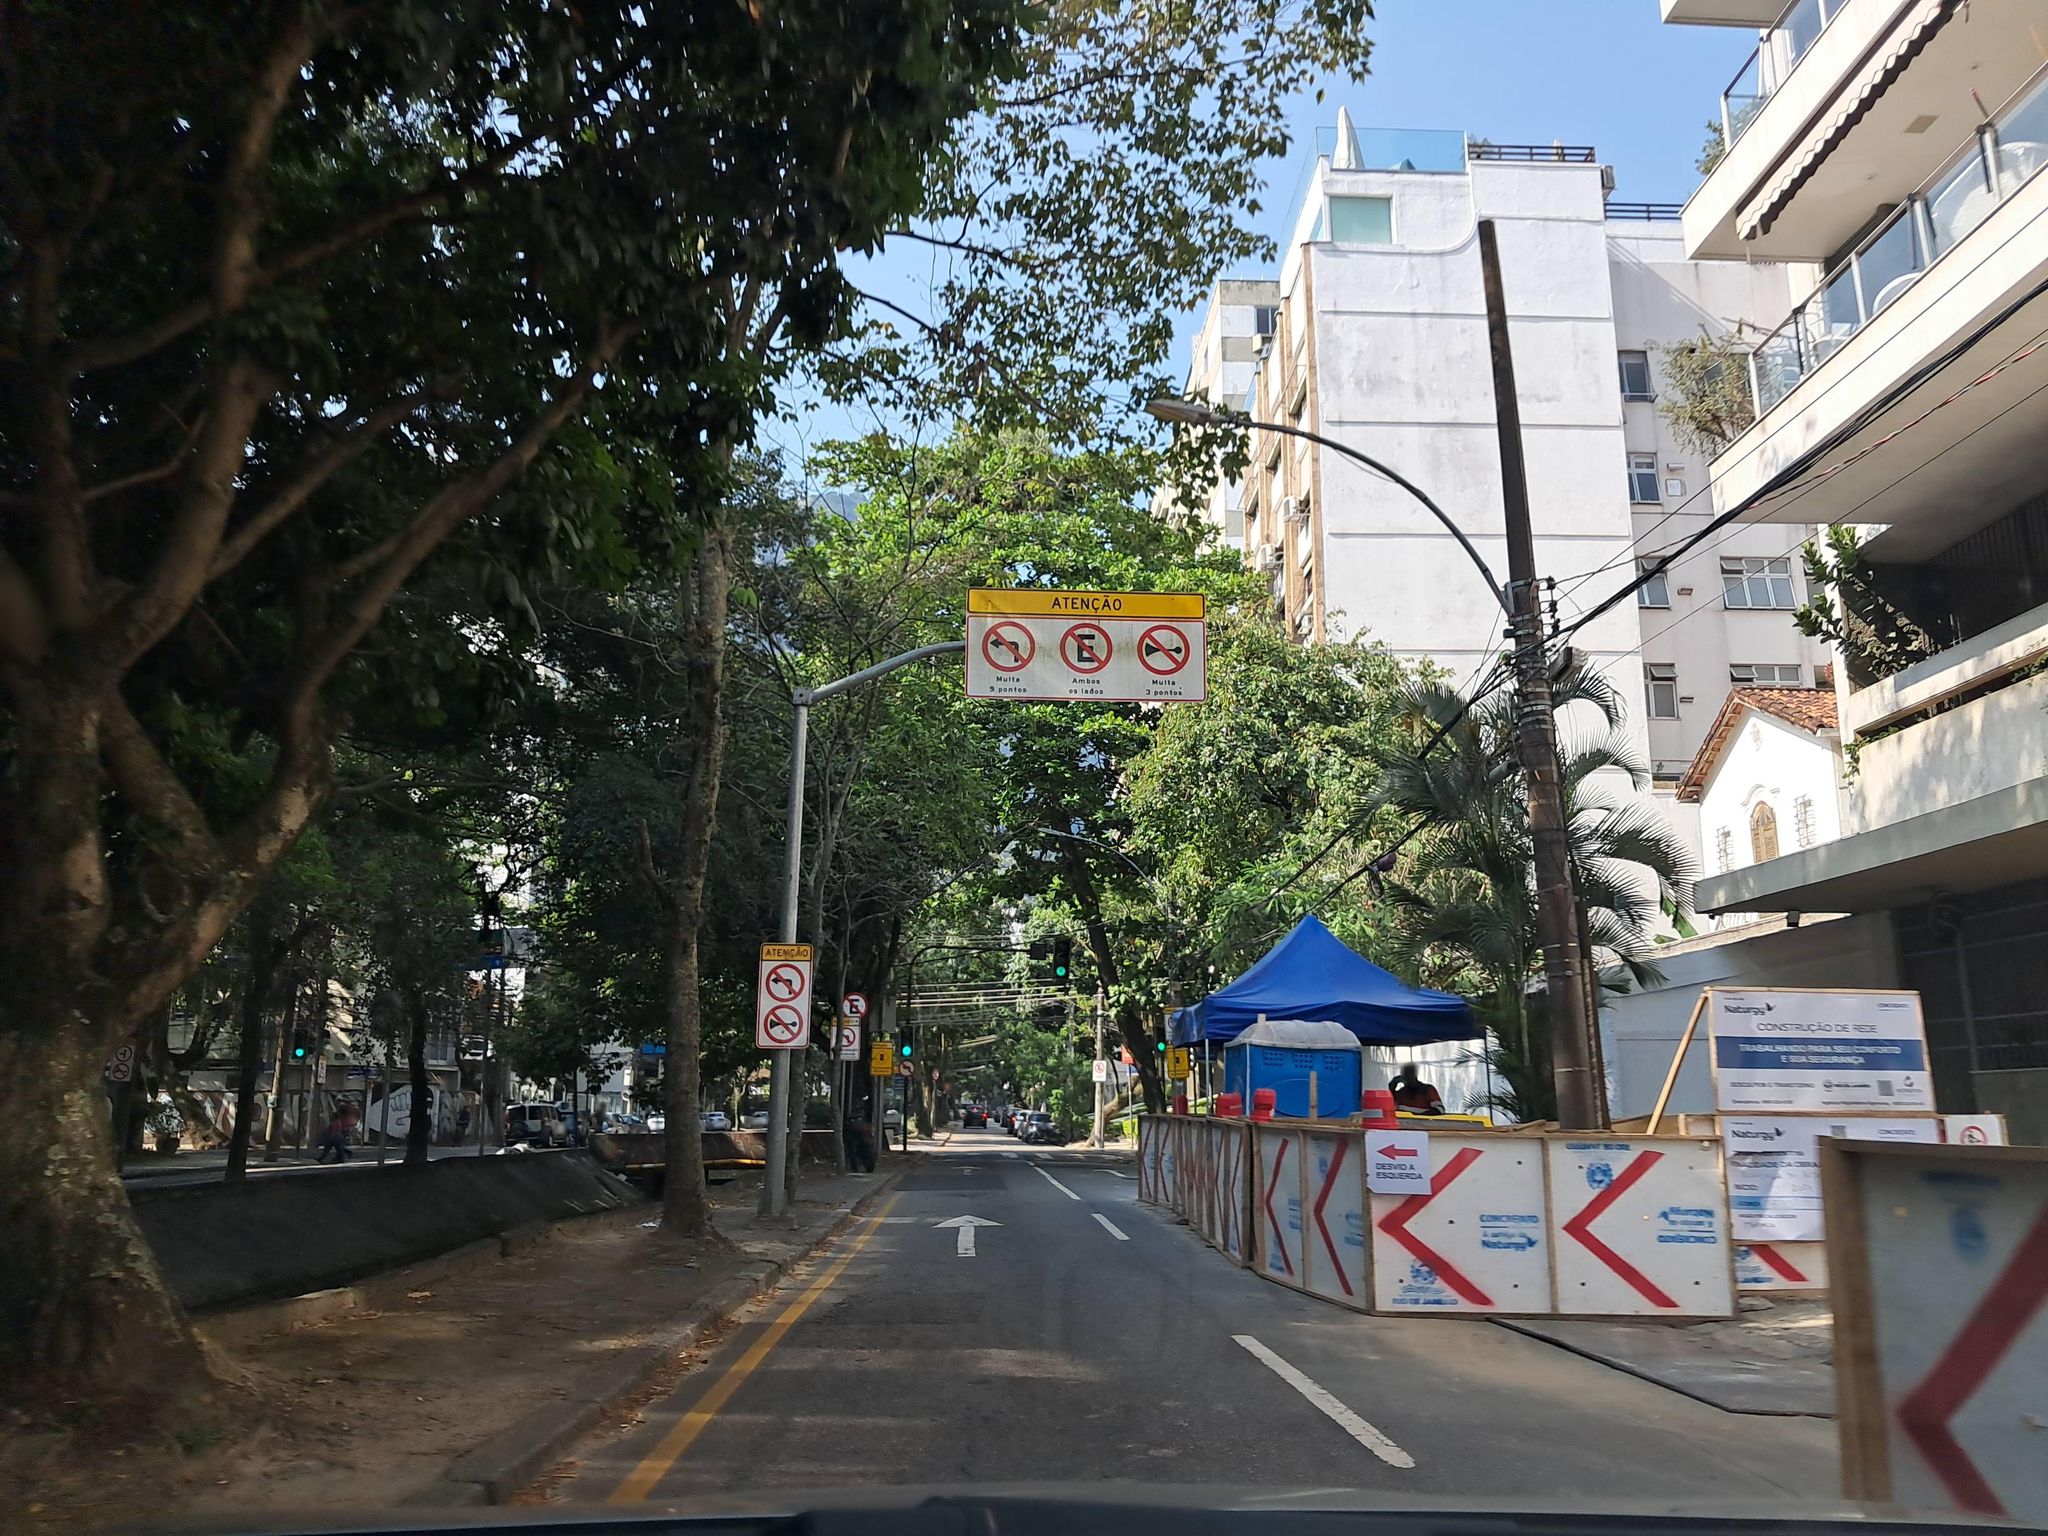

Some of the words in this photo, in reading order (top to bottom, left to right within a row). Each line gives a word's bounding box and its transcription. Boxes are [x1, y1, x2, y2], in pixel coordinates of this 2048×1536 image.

[1051, 595, 1123, 614] ATENÇÃO
[998, 686, 1027, 695] pontos
[1079, 687, 1104, 695] lados
[1153, 689, 1183, 698] pontos
[765, 946, 809, 959] ATENÇÃO
[1723, 1004, 1766, 1016] Naturgy
[1756, 1021, 1834, 1034] CONSTRUÇÃO
[1834, 1023, 1851, 1033] DE
[1852, 1024, 1878, 1034] REDE
[1738, 1043, 1806, 1053] TRABALHANDO
[1807, 1045, 1832, 1053] PARA
[1853, 1046, 1902, 1055] CONFORTO
[1780, 1055, 1788, 1063] E
[1807, 1055, 1866, 1065] SEGURANÇA
[1731, 1129, 1775, 1141] Naturgy
[1375, 1162, 1408, 1170] DESVIO
[1409, 1163, 1416, 1171] A
[1375, 1171, 1424, 1180] ESQUERDA
